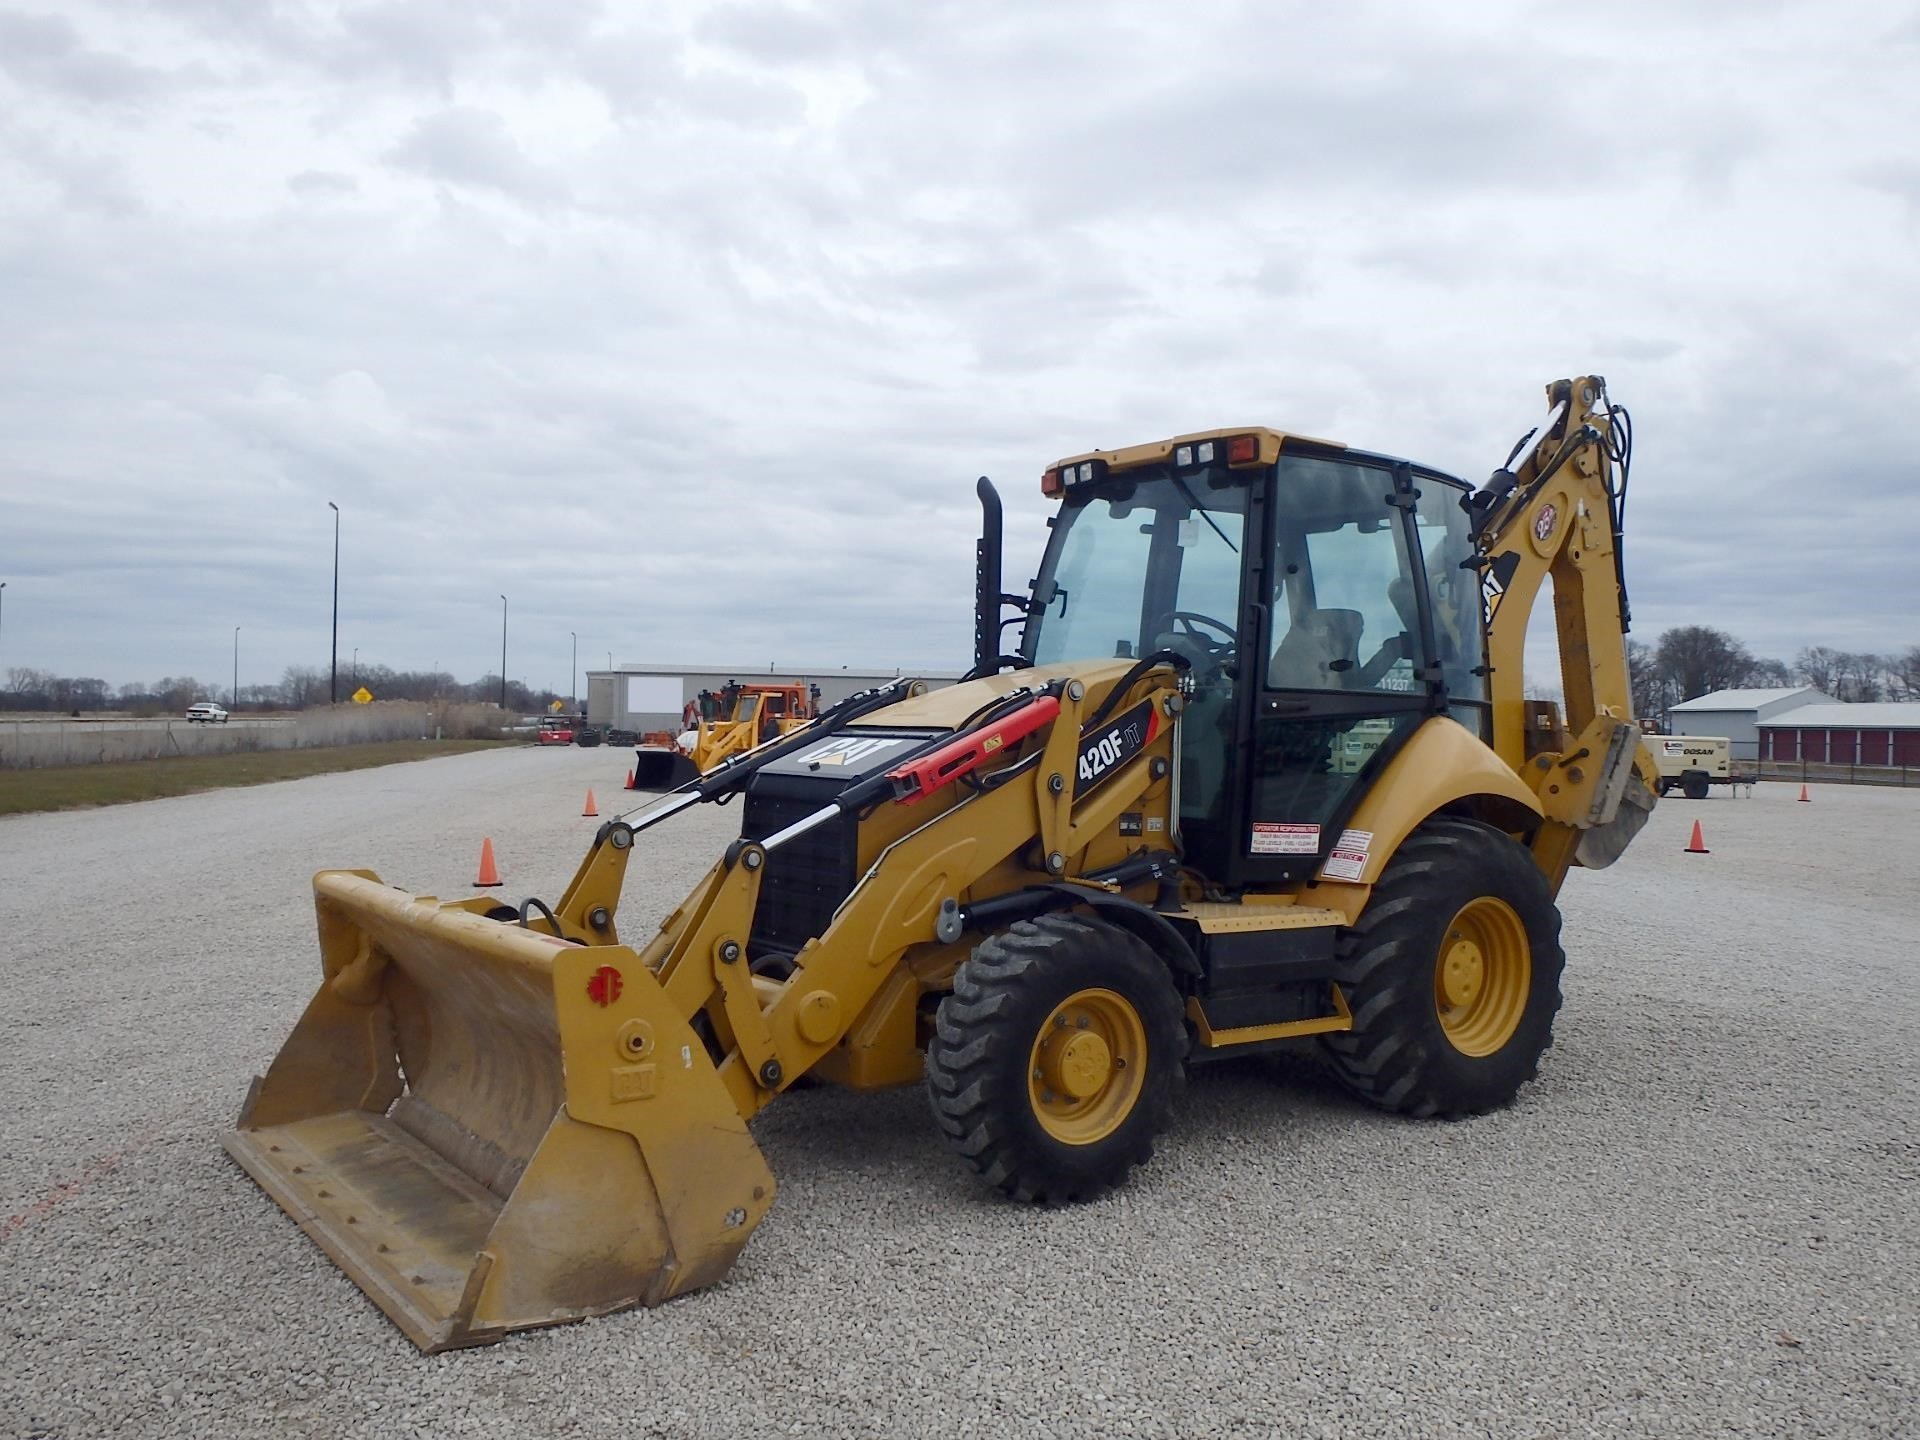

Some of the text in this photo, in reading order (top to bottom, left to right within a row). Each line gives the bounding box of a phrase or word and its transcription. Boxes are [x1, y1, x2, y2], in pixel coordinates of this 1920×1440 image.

[1380, 678, 1409, 691] 11237
[797, 737, 904, 766] CAT
[1078, 728, 1122, 781] 420F
[1335, 853, 1360, 861] NOTICE
[620, 1071, 653, 1093] CAT
